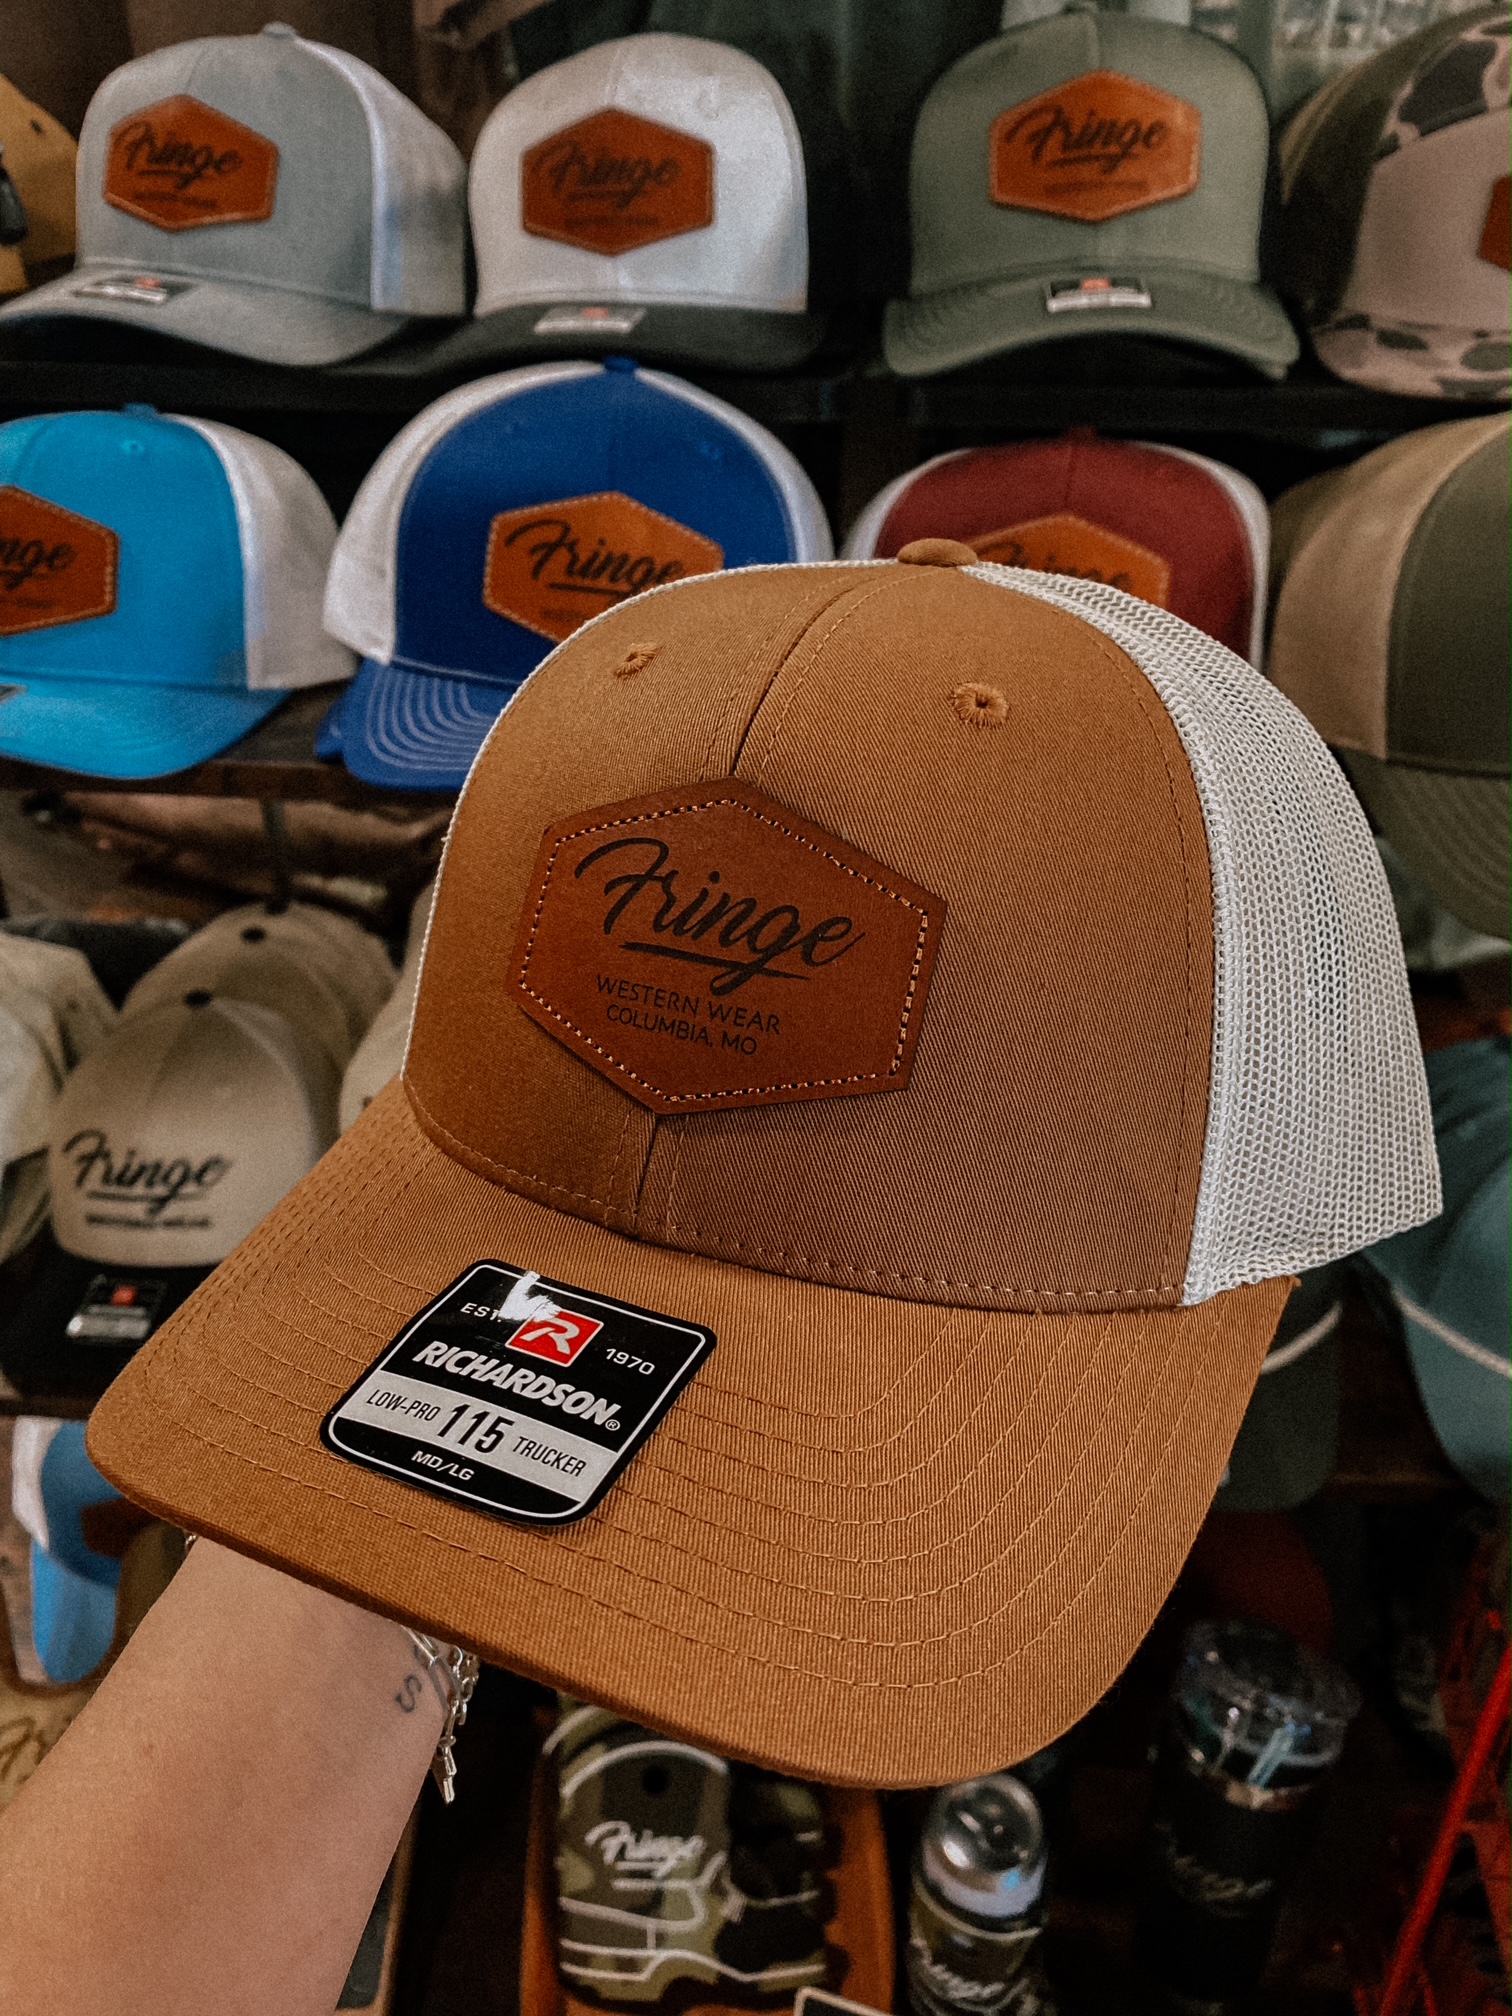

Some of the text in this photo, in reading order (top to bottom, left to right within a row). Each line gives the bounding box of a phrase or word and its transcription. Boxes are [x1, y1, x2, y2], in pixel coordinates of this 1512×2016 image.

[574, 837, 866, 996] Fringe
[597, 976, 781, 1036] WESTERN WEAR
[606, 1004, 758, 1056] COLUMBIA, MO
[62, 1129, 233, 1218] Fringe
[605, 1347, 655, 1376] 1970
[366, 1389, 587, 1478] LOW-PRO 115 TRUCKER
[410, 1450, 475, 1481] MD/LG
